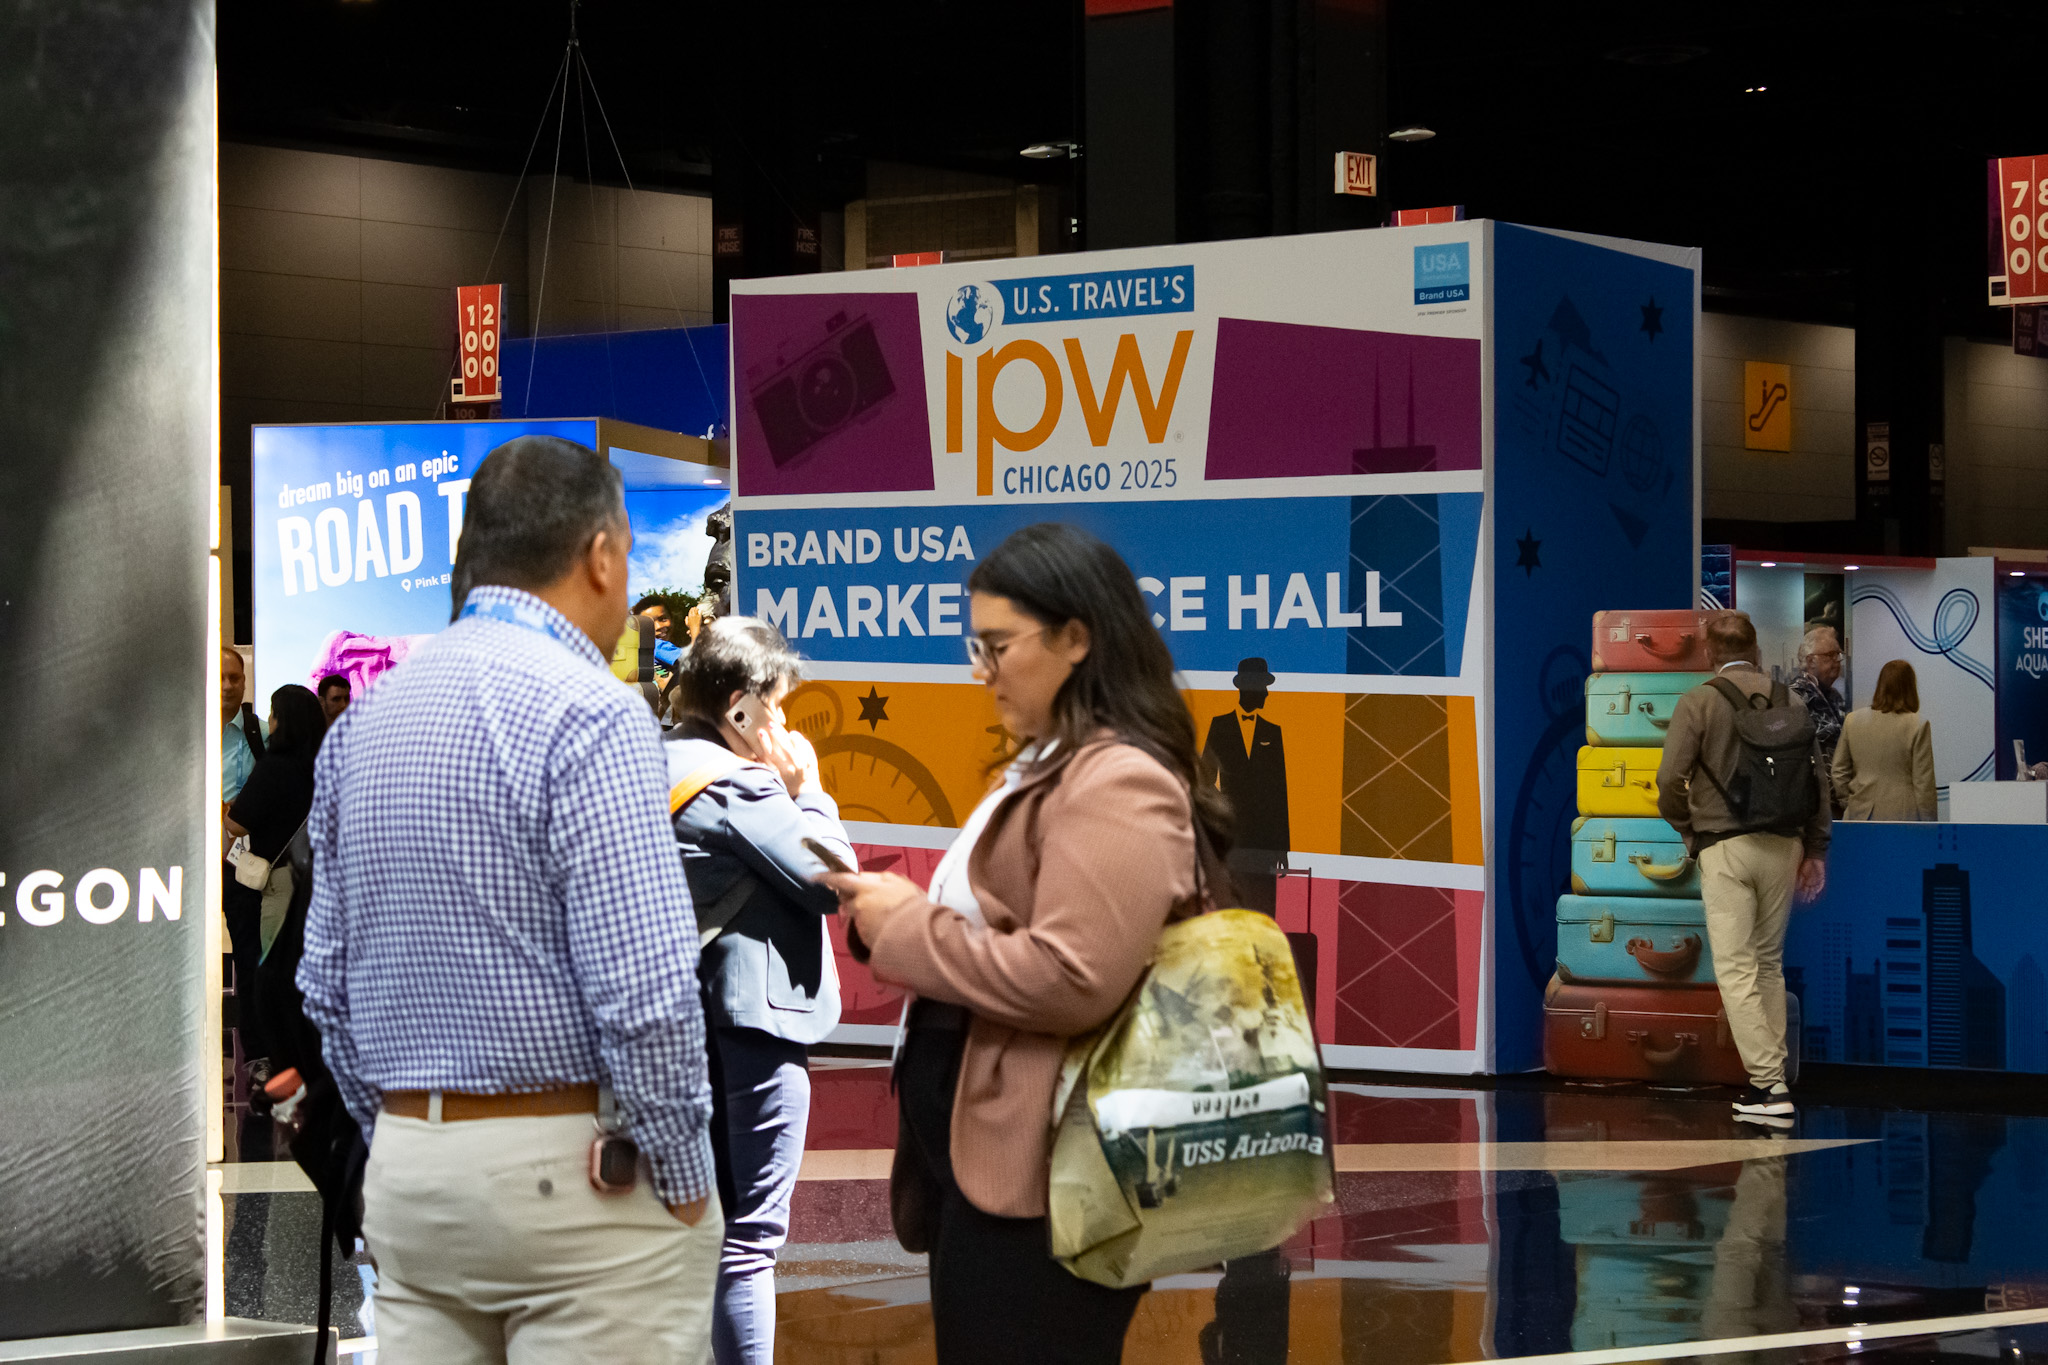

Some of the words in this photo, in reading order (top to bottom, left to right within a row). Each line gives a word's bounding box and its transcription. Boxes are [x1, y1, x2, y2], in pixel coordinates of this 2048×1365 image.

[1347, 155, 1372, 185] EXIT
[717, 241, 740, 254] HOSE
[719, 227, 739, 240] FIRE
[796, 241, 817, 254] HOSE
[797, 227, 815, 240] FIRE
[1422, 252, 1461, 273] USA
[1013, 284, 1060, 316] U.S.
[1068, 274, 1186, 312] TRAVEL'S
[1419, 290, 1444, 301] Brand
[1446, 288, 1464, 298] USA
[946, 329, 1195, 496] ipw
[278, 482, 332, 509] dream
[336, 470, 364, 498] big
[368, 468, 390, 489] on
[395, 463, 417, 483] an
[421, 450, 459, 483] epic
[1003, 462, 1111, 495] CHICAGO
[1120, 458, 1177, 490] 2025
[277, 490, 424, 597] ROAD
[748, 528, 882, 568] BRAND
[893, 525, 976, 563] USA
[415, 575, 439, 589] Pink
[1228, 570, 1403, 631] HALL
[0, 865, 183, 928] GON
[1183, 1138, 1227, 1168] USS
[1228, 1131, 1324, 1161] Arizona
